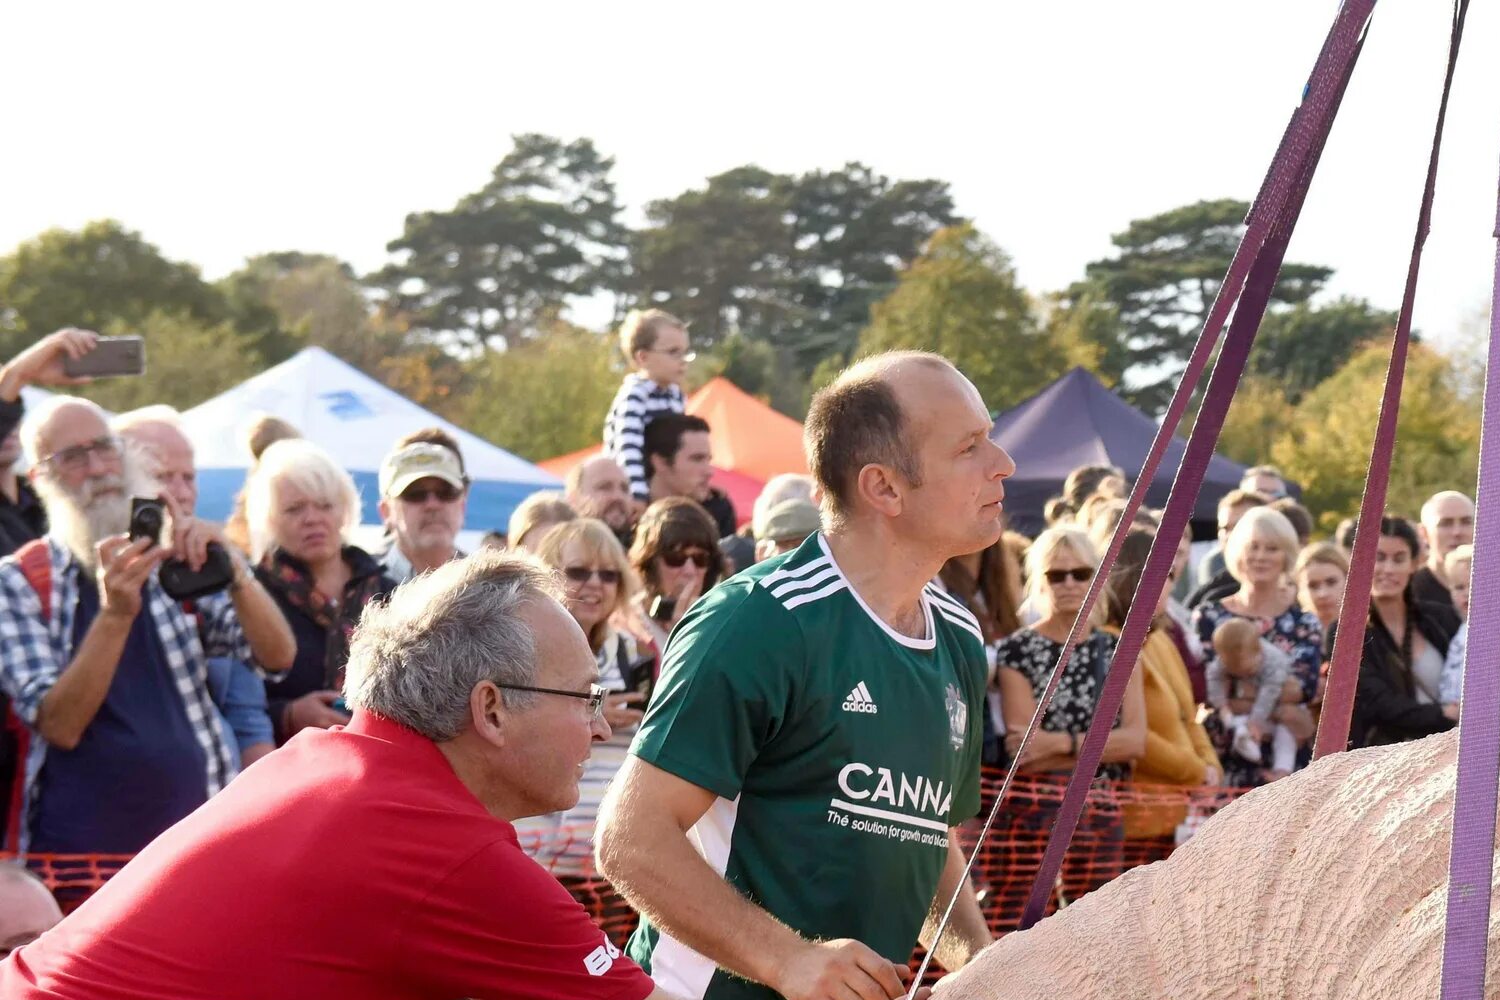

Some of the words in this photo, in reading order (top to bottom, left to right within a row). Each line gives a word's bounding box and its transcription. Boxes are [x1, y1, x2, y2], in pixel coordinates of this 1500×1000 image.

[842, 700, 878, 714] adidas
[851, 818, 888, 836] solution
[888, 824, 901, 839] for
[921, 833, 934, 845] and
